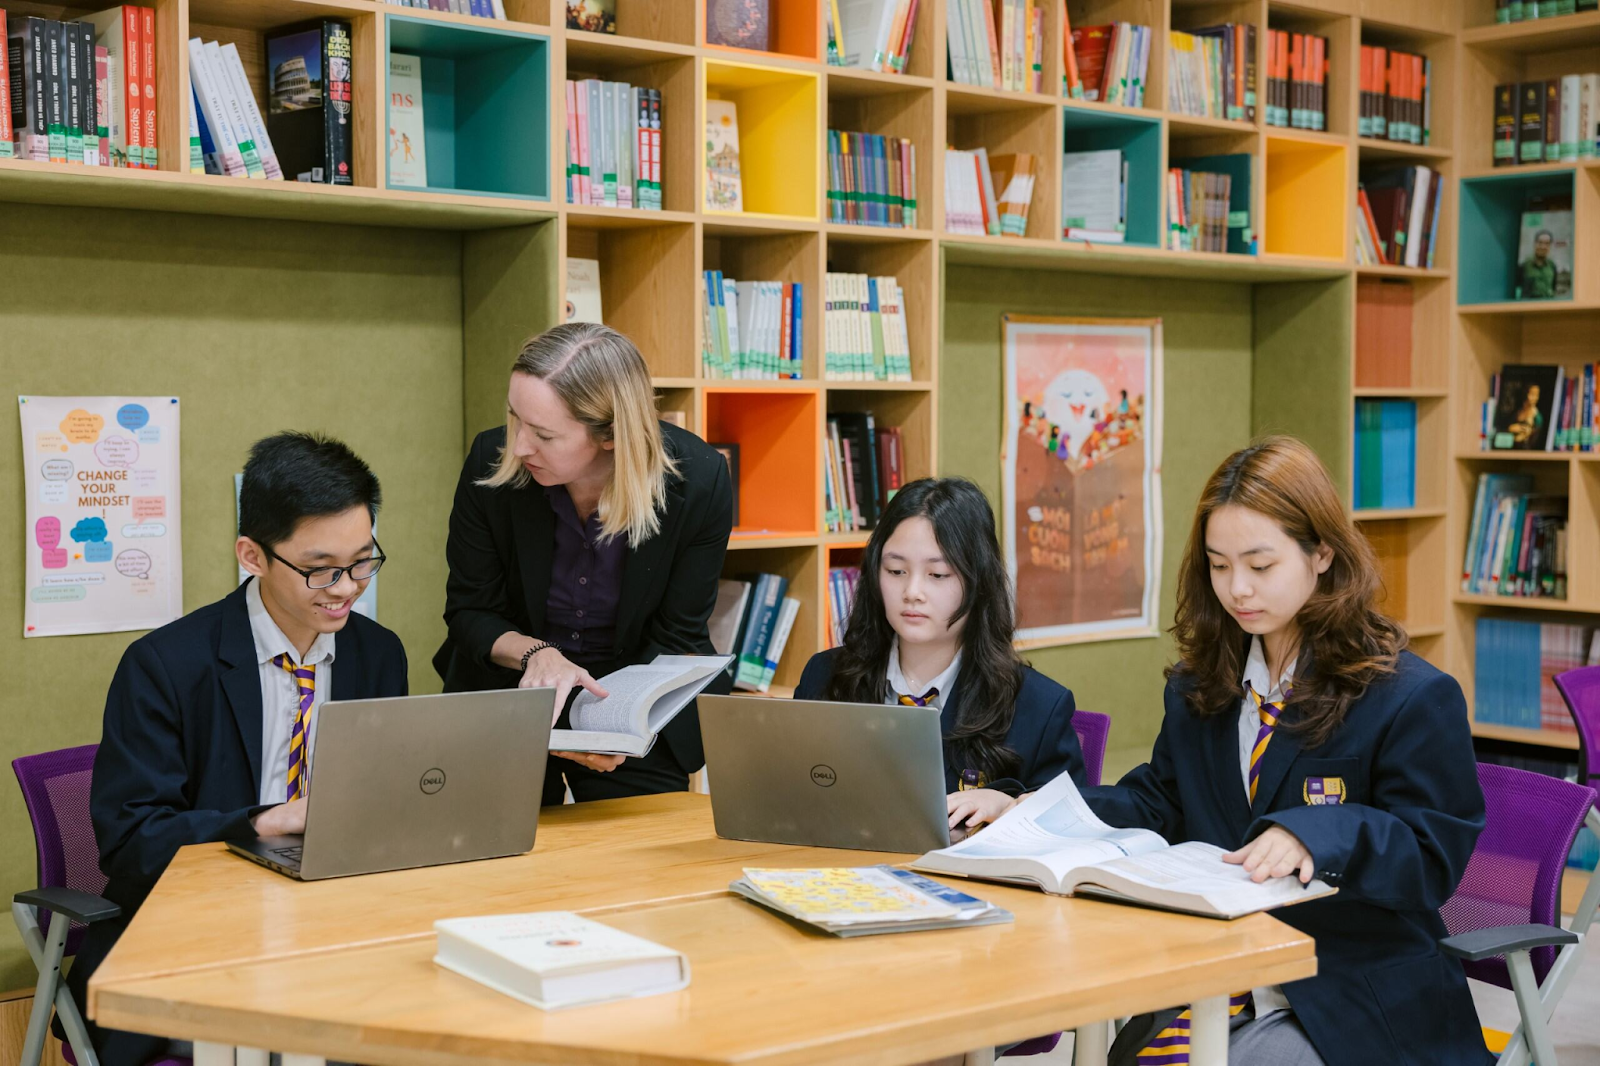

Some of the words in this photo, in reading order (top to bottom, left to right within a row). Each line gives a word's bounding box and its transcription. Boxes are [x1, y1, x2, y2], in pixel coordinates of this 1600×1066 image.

[77, 470, 128, 481] CHANGE
[81, 484, 116, 494] YOUR
[78, 496, 130, 507] MINDSET
[102, 509, 105, 519] !
[423, 777, 442, 786] DELL
